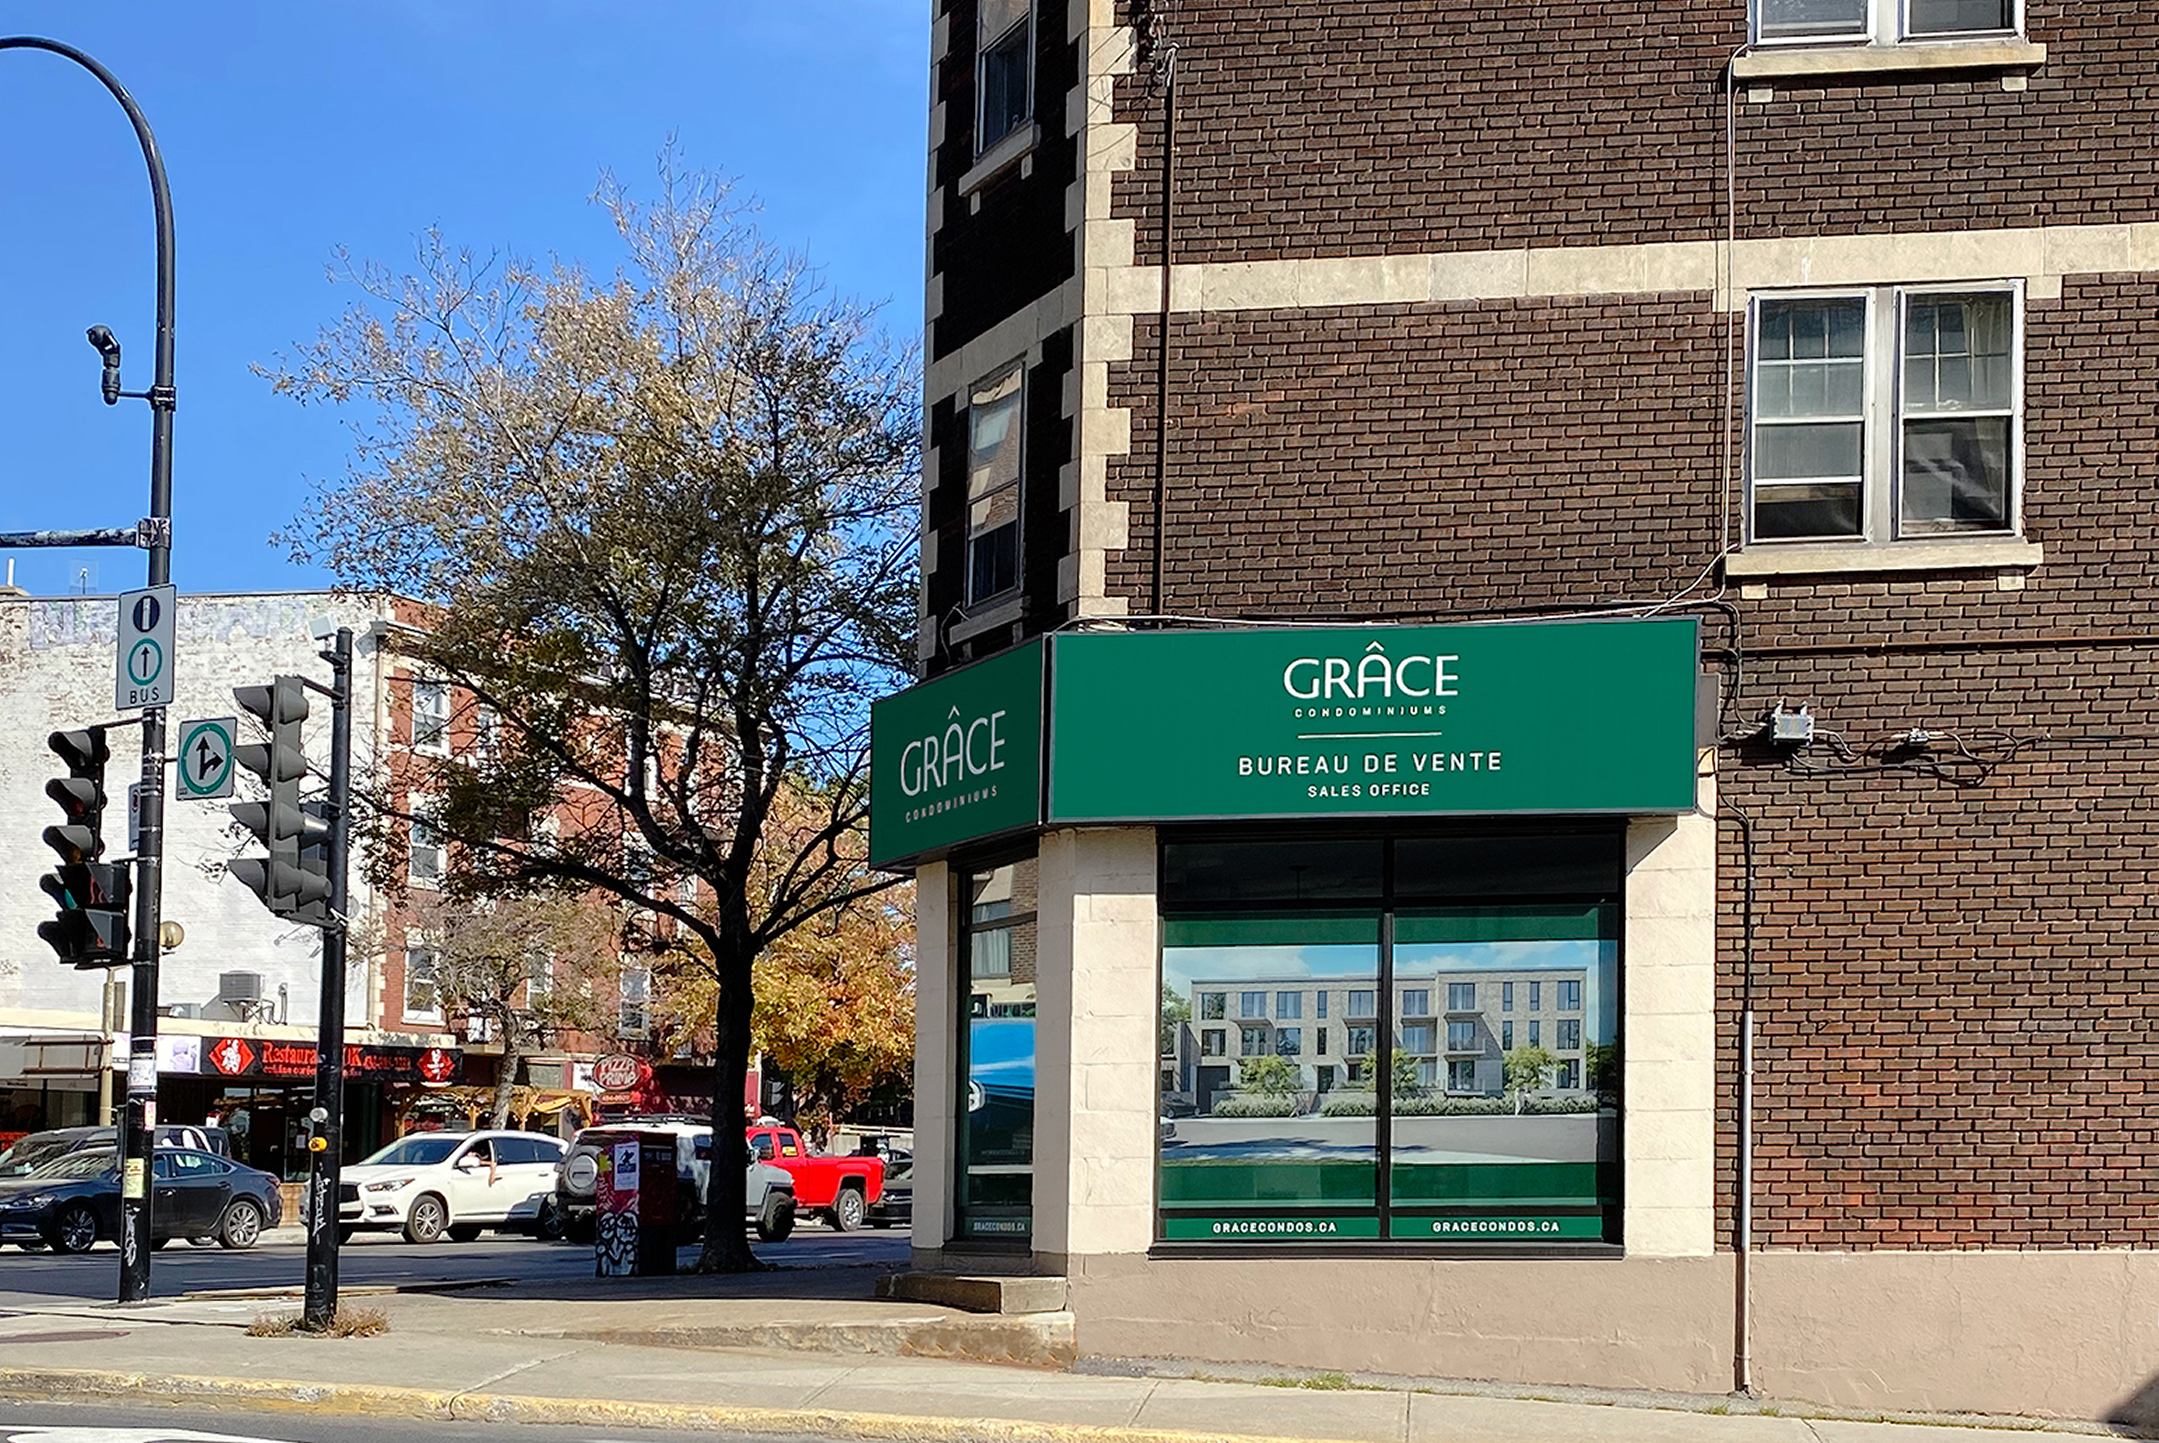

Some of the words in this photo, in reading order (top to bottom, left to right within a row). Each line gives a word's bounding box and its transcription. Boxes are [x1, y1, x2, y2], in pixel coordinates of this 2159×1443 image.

[1283, 640, 1459, 699] GRÂCE
[129, 687, 160, 704] BUS
[1295, 705, 1447, 718] CONDOMINIUMS
[901, 705, 1006, 796] GRÂCE
[1239, 755, 1348, 777] BUREAU
[1364, 754, 1398, 775] DE
[1412, 752, 1502, 774] VENTE
[1307, 785, 1361, 798] SALES
[1369, 784, 1430, 797] OFFICE
[905, 784, 998, 823] CONDOMINIUMS
[262, 1042, 317, 1064] Restaura
[600, 1058, 635, 1073] PIZZA
[599, 1071, 637, 1087] PRIMA
[1212, 1221, 1337, 1234] GRACECONDOS.CA
[1432, 1221, 1560, 1234] GRACECONDOS.CA
